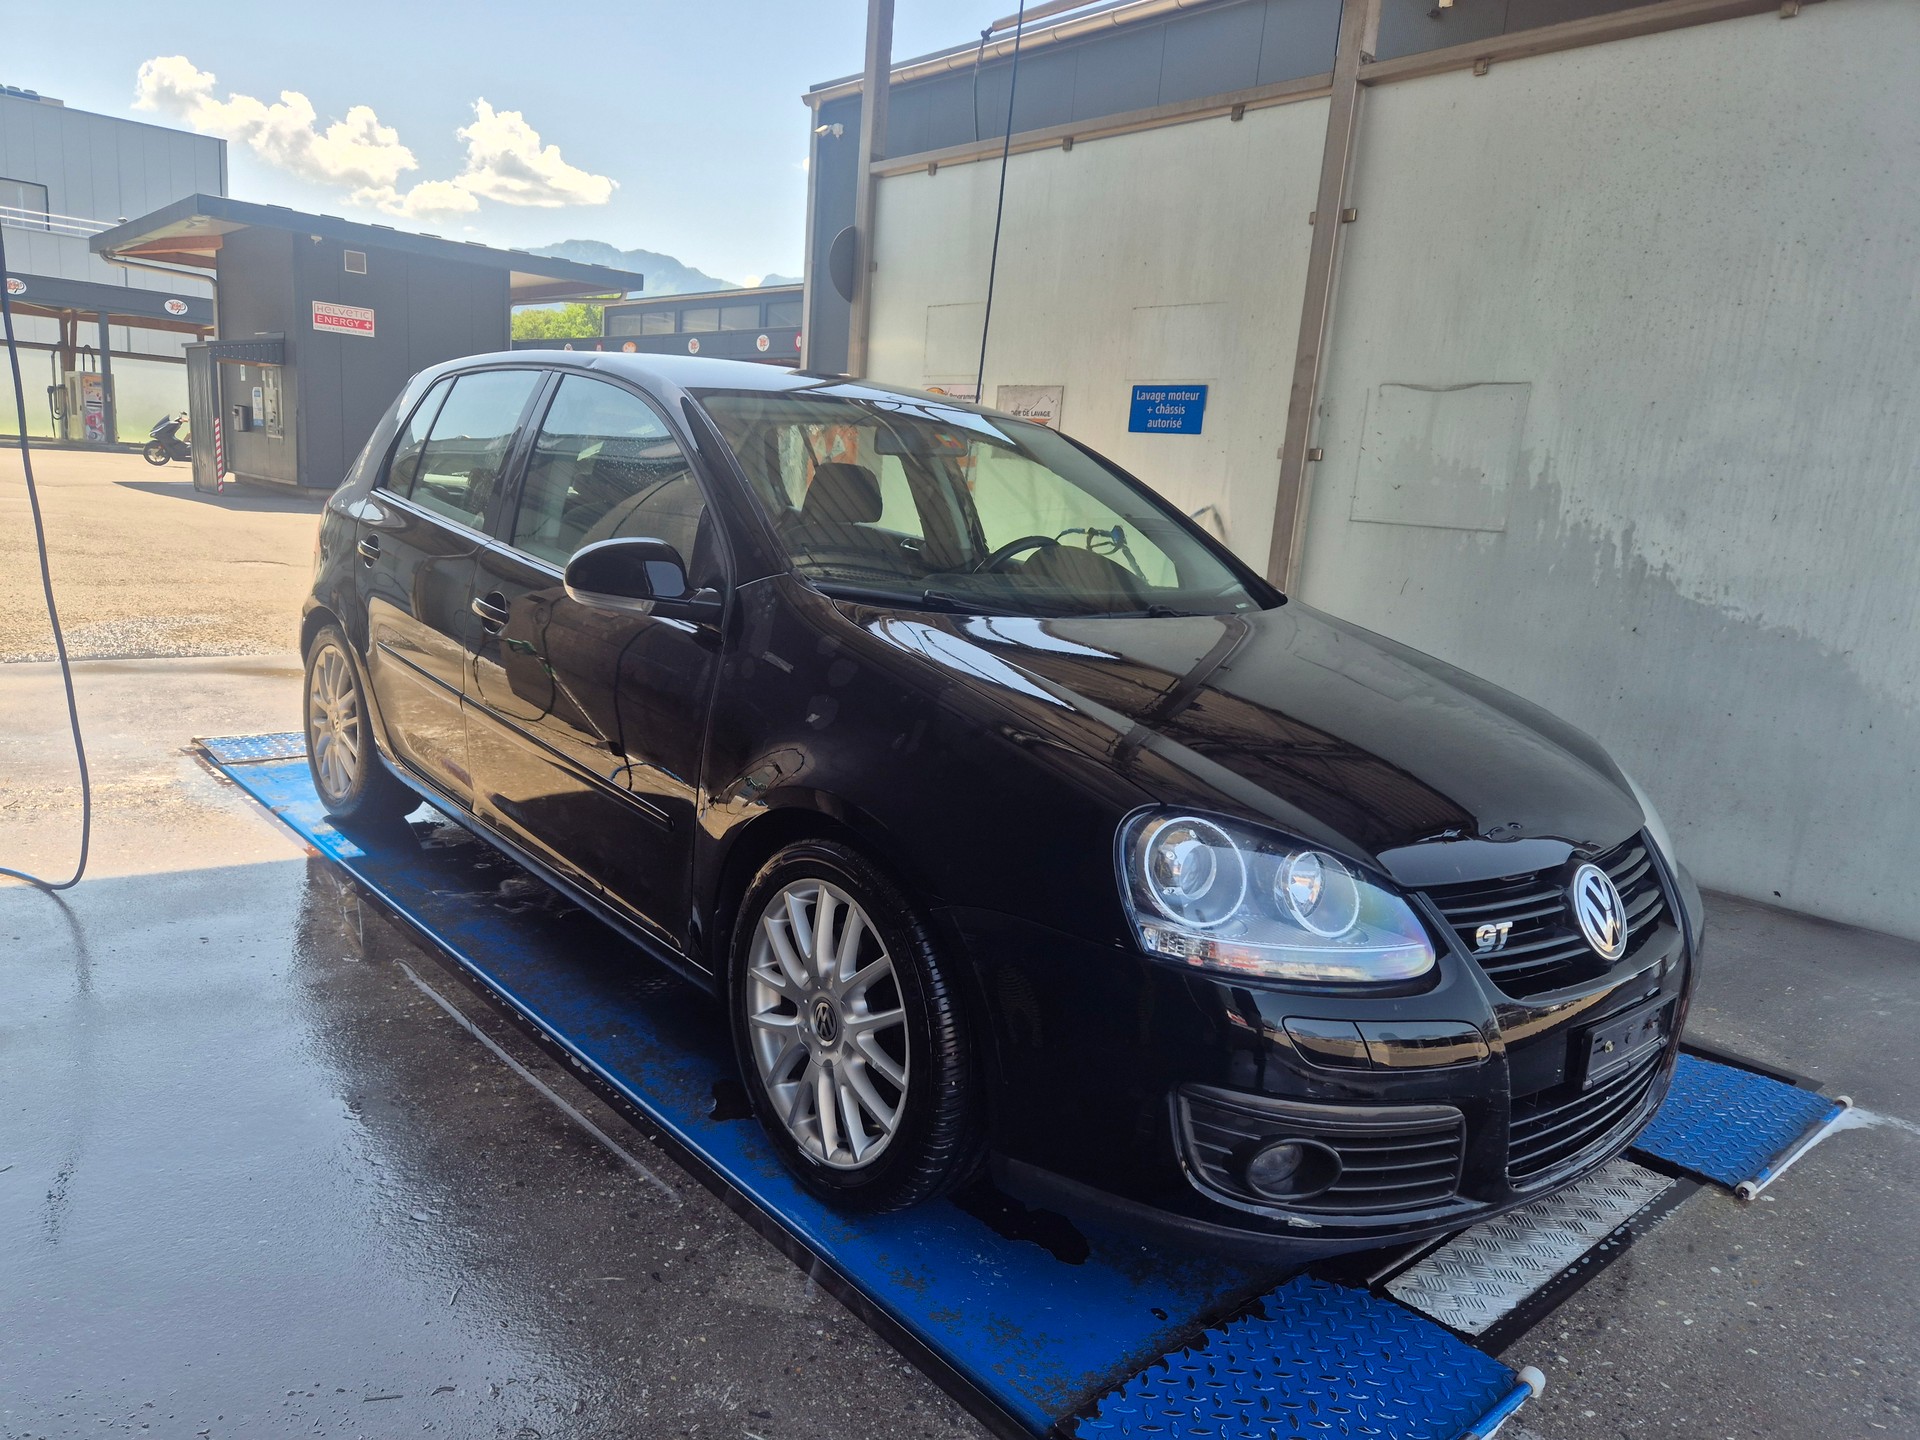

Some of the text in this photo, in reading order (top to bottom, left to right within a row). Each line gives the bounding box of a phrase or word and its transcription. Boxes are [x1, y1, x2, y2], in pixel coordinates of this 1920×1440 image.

[317, 315, 360, 327] ENERGY
[1136, 390, 1200, 403] Lavage moteur
[1031, 410, 1051, 418] LAVAGE
[1155, 403, 1186, 414] châssis
[1147, 417, 1182, 428] autorisé
[1475, 921, 1513, 949] GT
